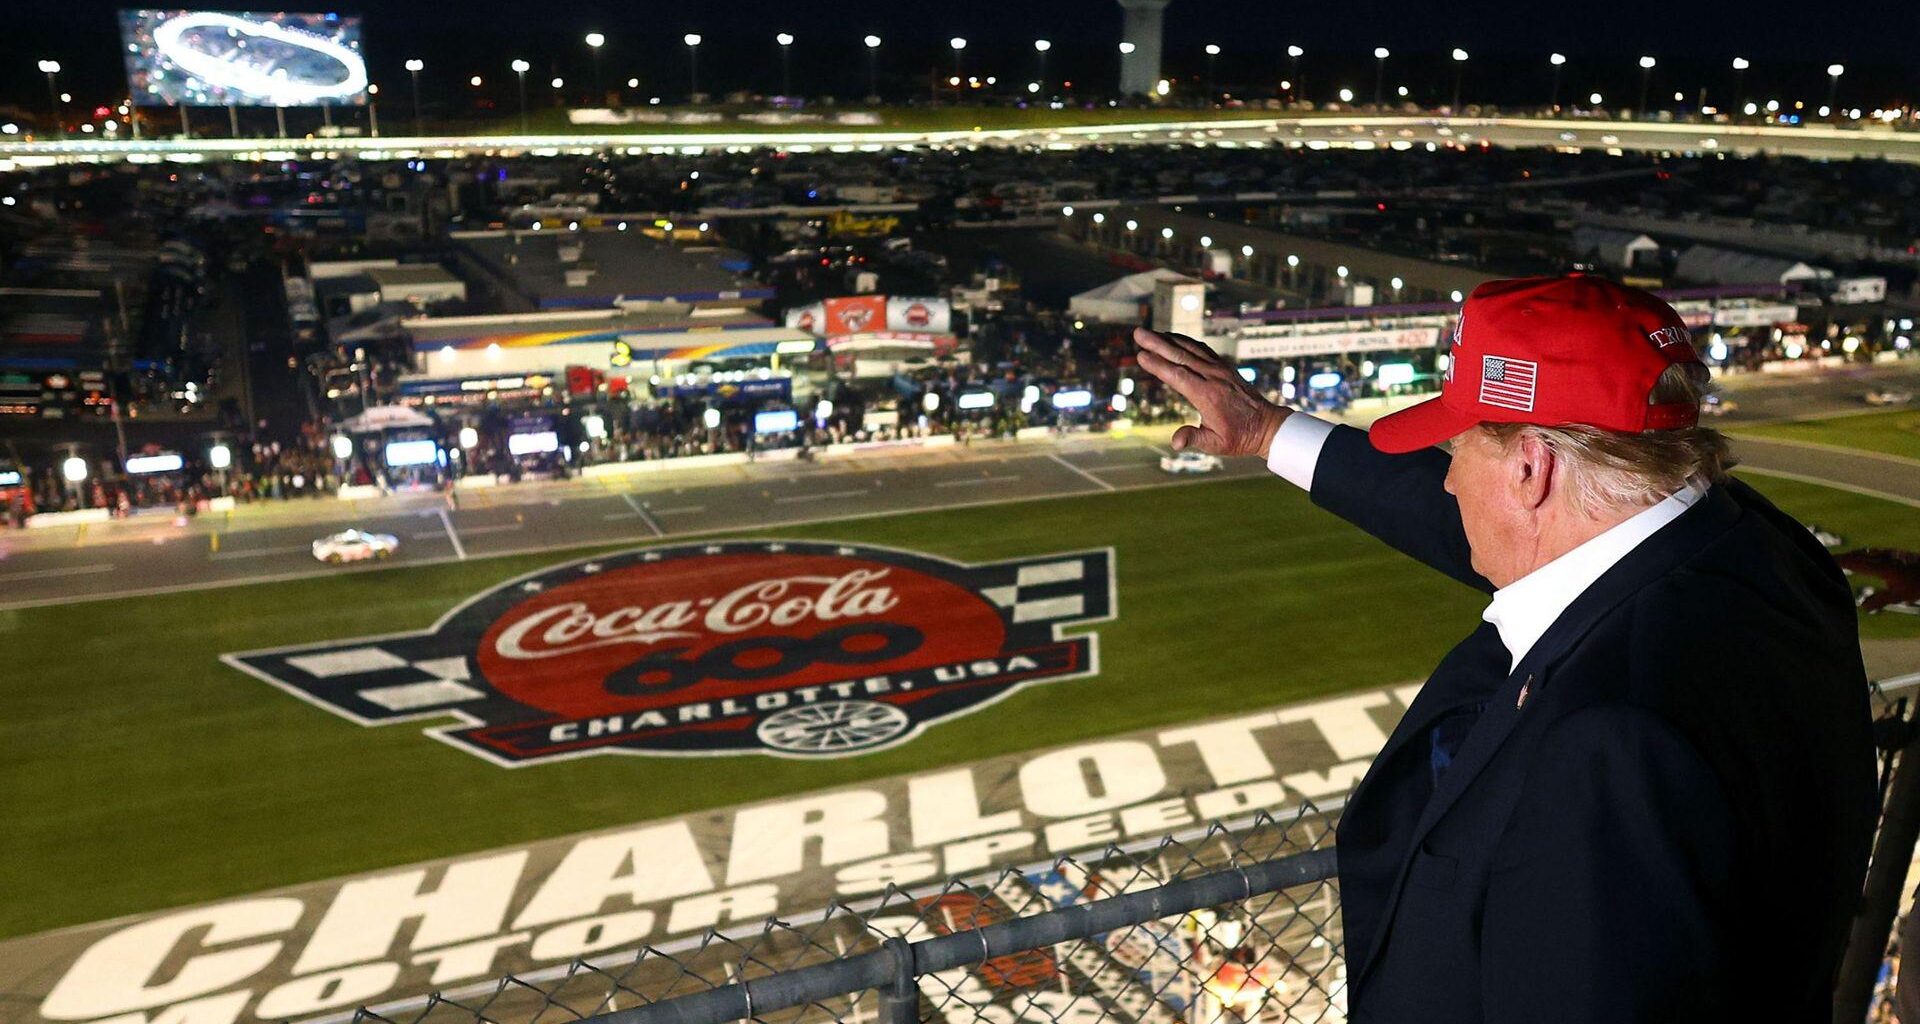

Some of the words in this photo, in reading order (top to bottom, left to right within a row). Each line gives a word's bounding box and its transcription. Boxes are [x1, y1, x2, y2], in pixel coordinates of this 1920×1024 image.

[495, 566, 899, 660] Coca-Cola
[602, 622, 925, 697] 600
[934, 653, 1041, 684] USA
[40, 682, 1425, 1021] CHARLOTT
[835, 759, 1373, 894] SPEEDW
